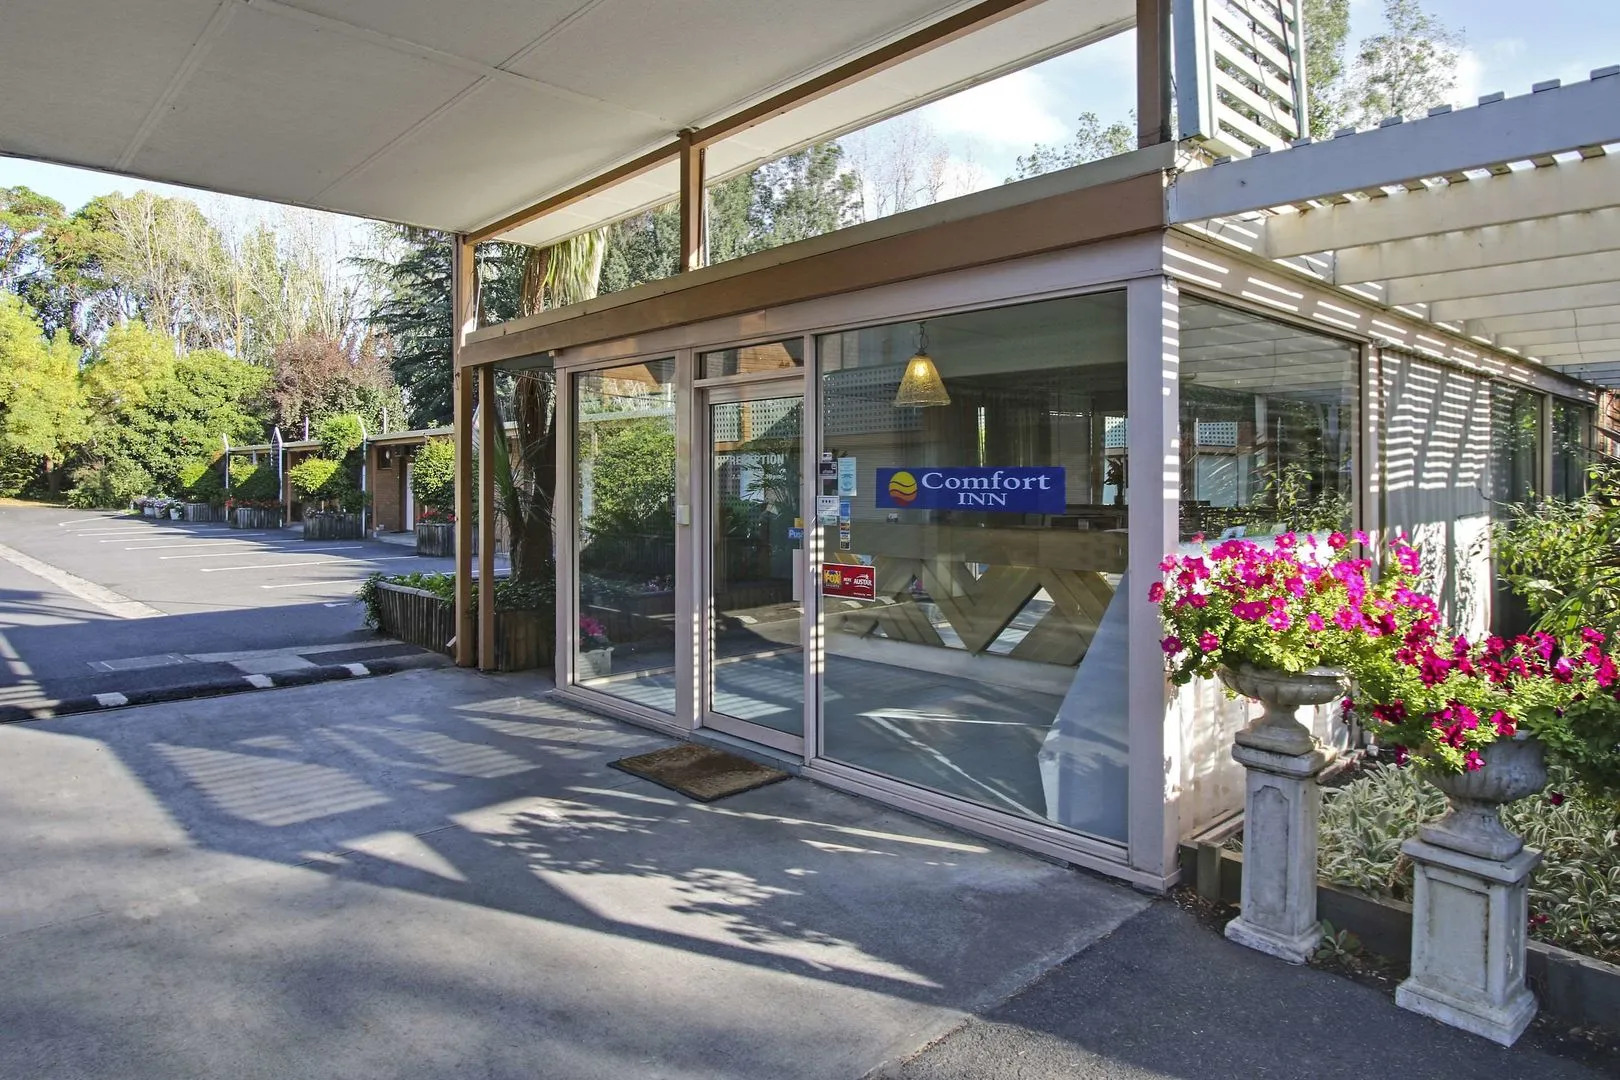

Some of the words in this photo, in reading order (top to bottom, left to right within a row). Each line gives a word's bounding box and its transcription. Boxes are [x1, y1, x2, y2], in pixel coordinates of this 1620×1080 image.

[921, 470, 1051, 490] Comfort
[957, 492, 1008, 506] INN
[824, 573, 841, 584] FOX
